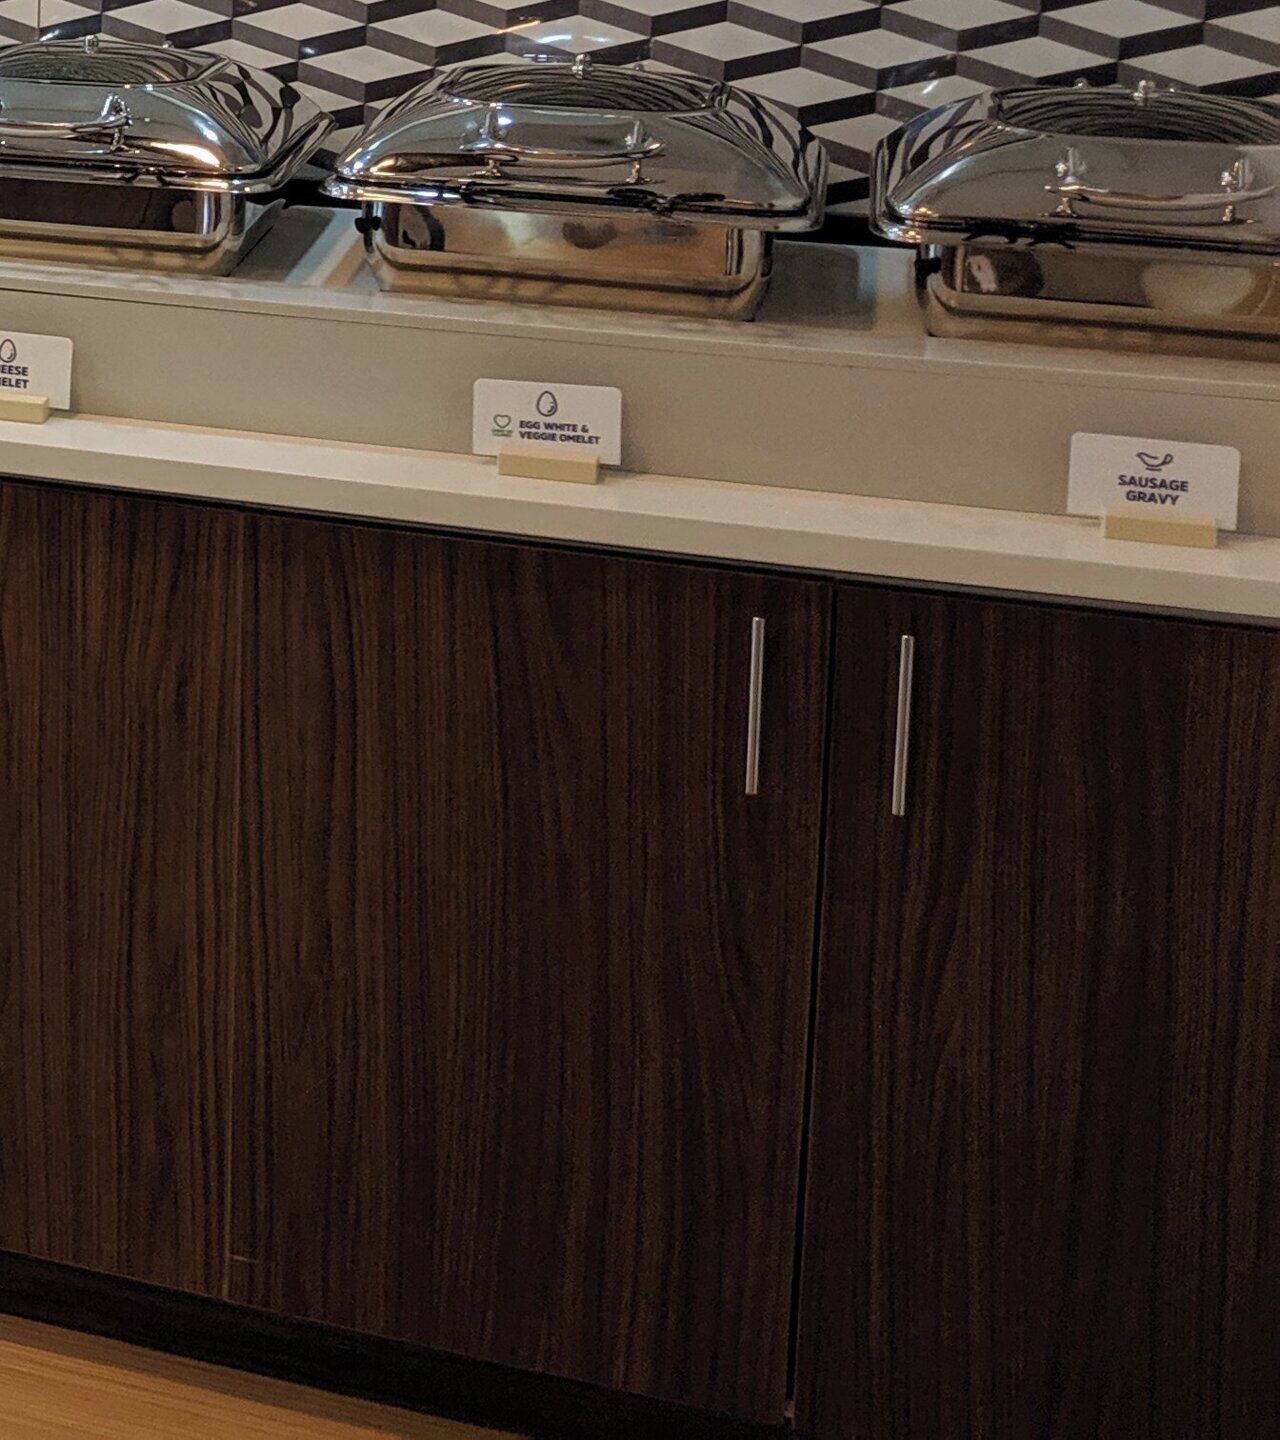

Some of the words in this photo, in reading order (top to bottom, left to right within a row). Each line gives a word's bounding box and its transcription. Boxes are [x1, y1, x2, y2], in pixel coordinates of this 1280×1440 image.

[519, 420, 541, 430] EGG
[543, 421, 578, 433] WHITE
[580, 424, 589, 434] &
[519, 431, 557, 442] VEGGIE
[558, 433, 601, 445] OMELET
[1118, 474, 1190, 493] SAUSAGE
[1125, 489, 1180, 506] GRAVY
